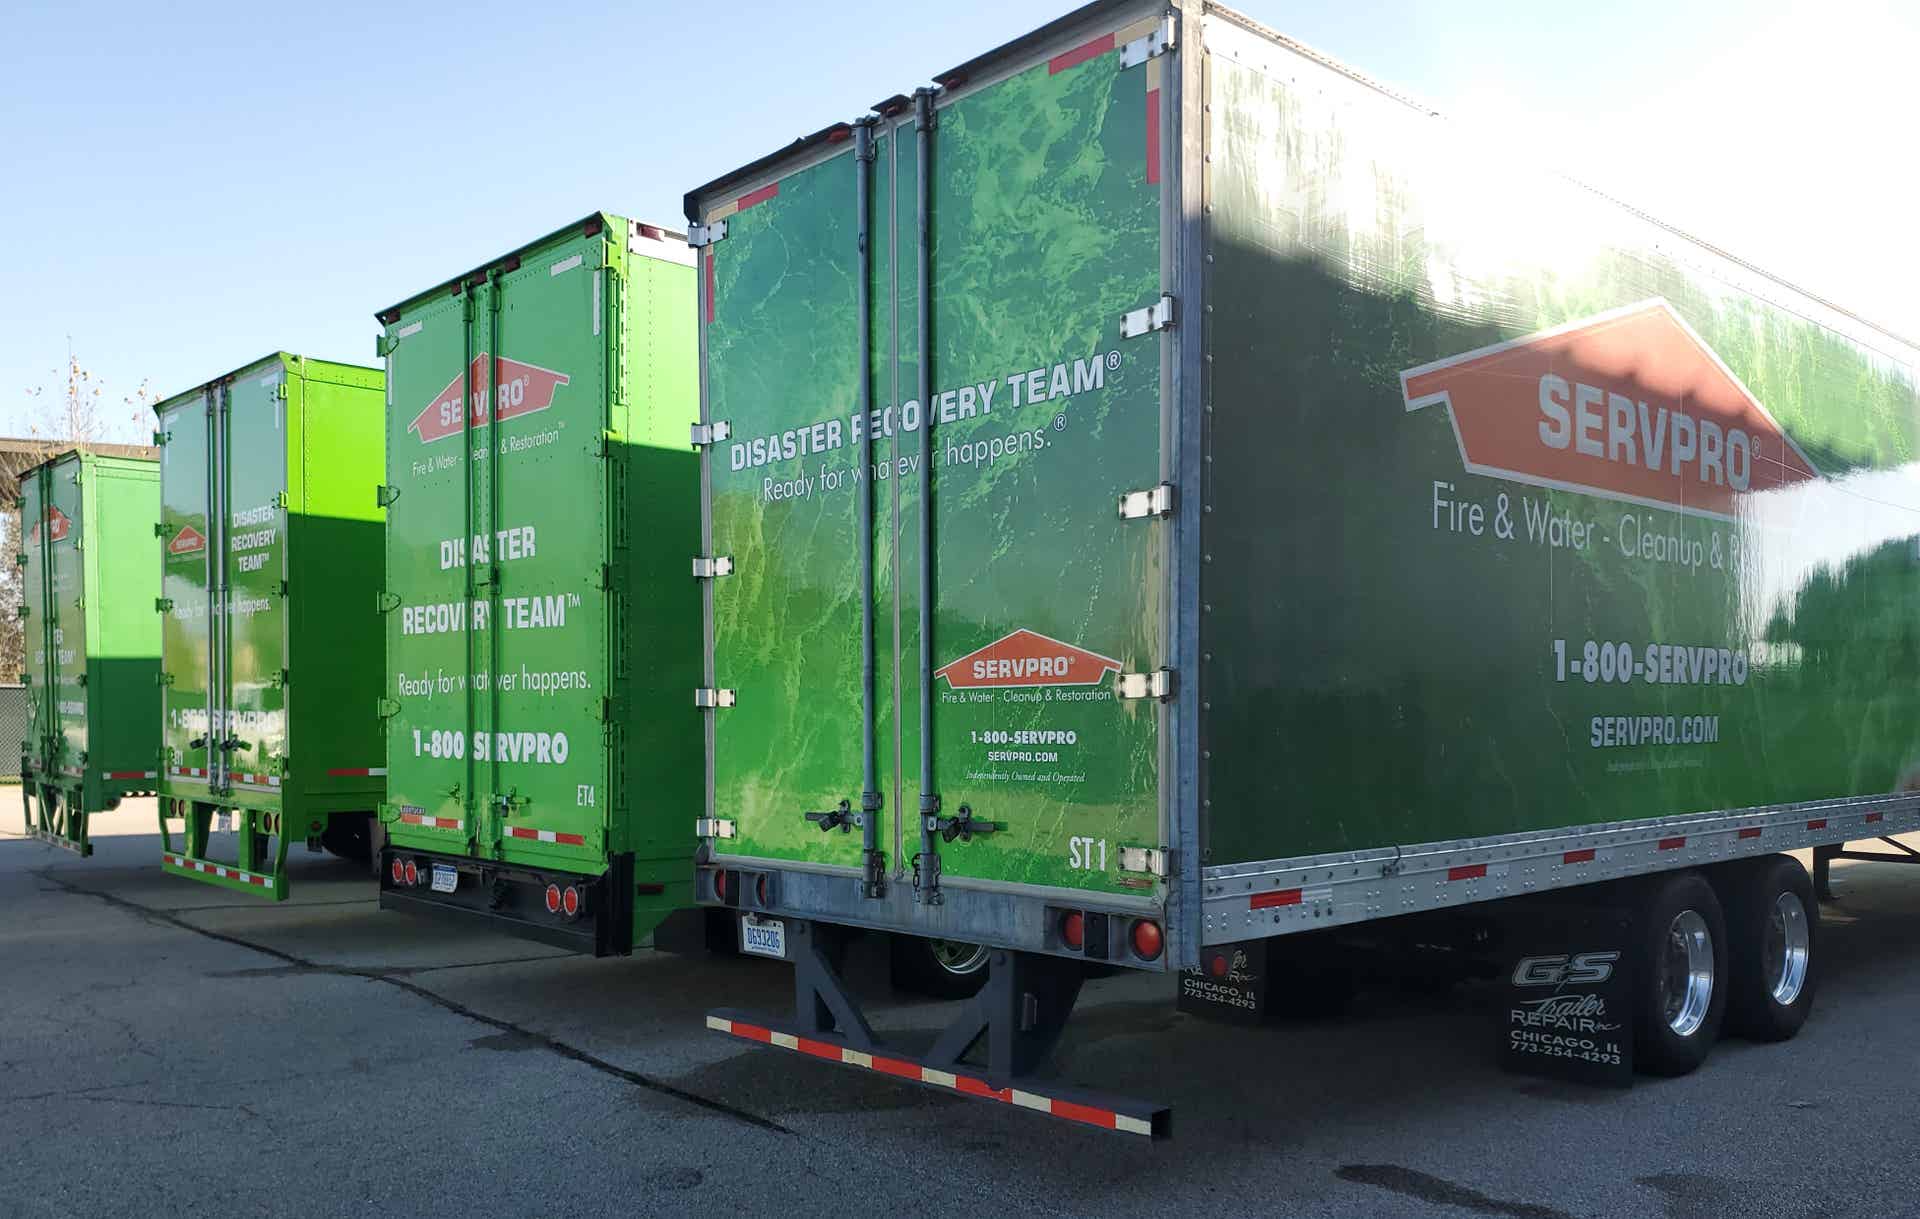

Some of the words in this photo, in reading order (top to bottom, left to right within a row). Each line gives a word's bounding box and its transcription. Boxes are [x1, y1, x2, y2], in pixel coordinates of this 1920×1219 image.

[731, 419, 842, 472] DISASTER
[412, 461, 427, 476] Fire
[428, 457, 434, 473] &
[436, 455, 458, 471] Water
[763, 475, 814, 502] Ready
[820, 463, 845, 491] for
[851, 450, 939, 484] waevr
[233, 504, 275, 528] DISASTER
[1432, 480, 1485, 537] Fire
[1495, 492, 1514, 540] &
[1523, 495, 1595, 550] Water
[1619, 513, 1703, 576] Cleanup
[1710, 530, 1723, 569] &
[231, 528, 277, 553] RECOVERY
[1554, 639, 1748, 686] 1-800-SERVPRO
[399, 670, 434, 701] Ready
[438, 668, 456, 694] for
[458, 669, 517, 692] watver
[522, 663, 592, 697] happens.
[942, 692, 957, 704] Fire
[959, 693, 966, 704] &
[968, 691, 993, 704] Water
[1003, 689, 1042, 705] Cleanup
[1045, 689, 1052, 701] &
[1056, 688, 1111, 701] Restoration
[971, 730, 1077, 745] 1-800-SERVPRO
[1590, 715, 1720, 748] SERVPRO.COM
[413, 729, 569, 764] 1-800SRVPRO
[988, 751, 1058, 762] SERVPRO.COM
[966, 769, 1009, 783] Independently
[1011, 770, 1035, 781] Owned
[1037, 771, 1050, 782] and
[1053, 771, 1086, 784] Operated
[577, 784, 595, 807] ET4
[1184, 986, 1256, 1010] 773-254-4293
[1511, 1009, 1597, 1034] REPAIR
[1511, 1030, 1600, 1053] CHICAGO,
[1606, 1042, 1621, 1055] IL
[1511, 1040, 1621, 1065] 773-254-4293
